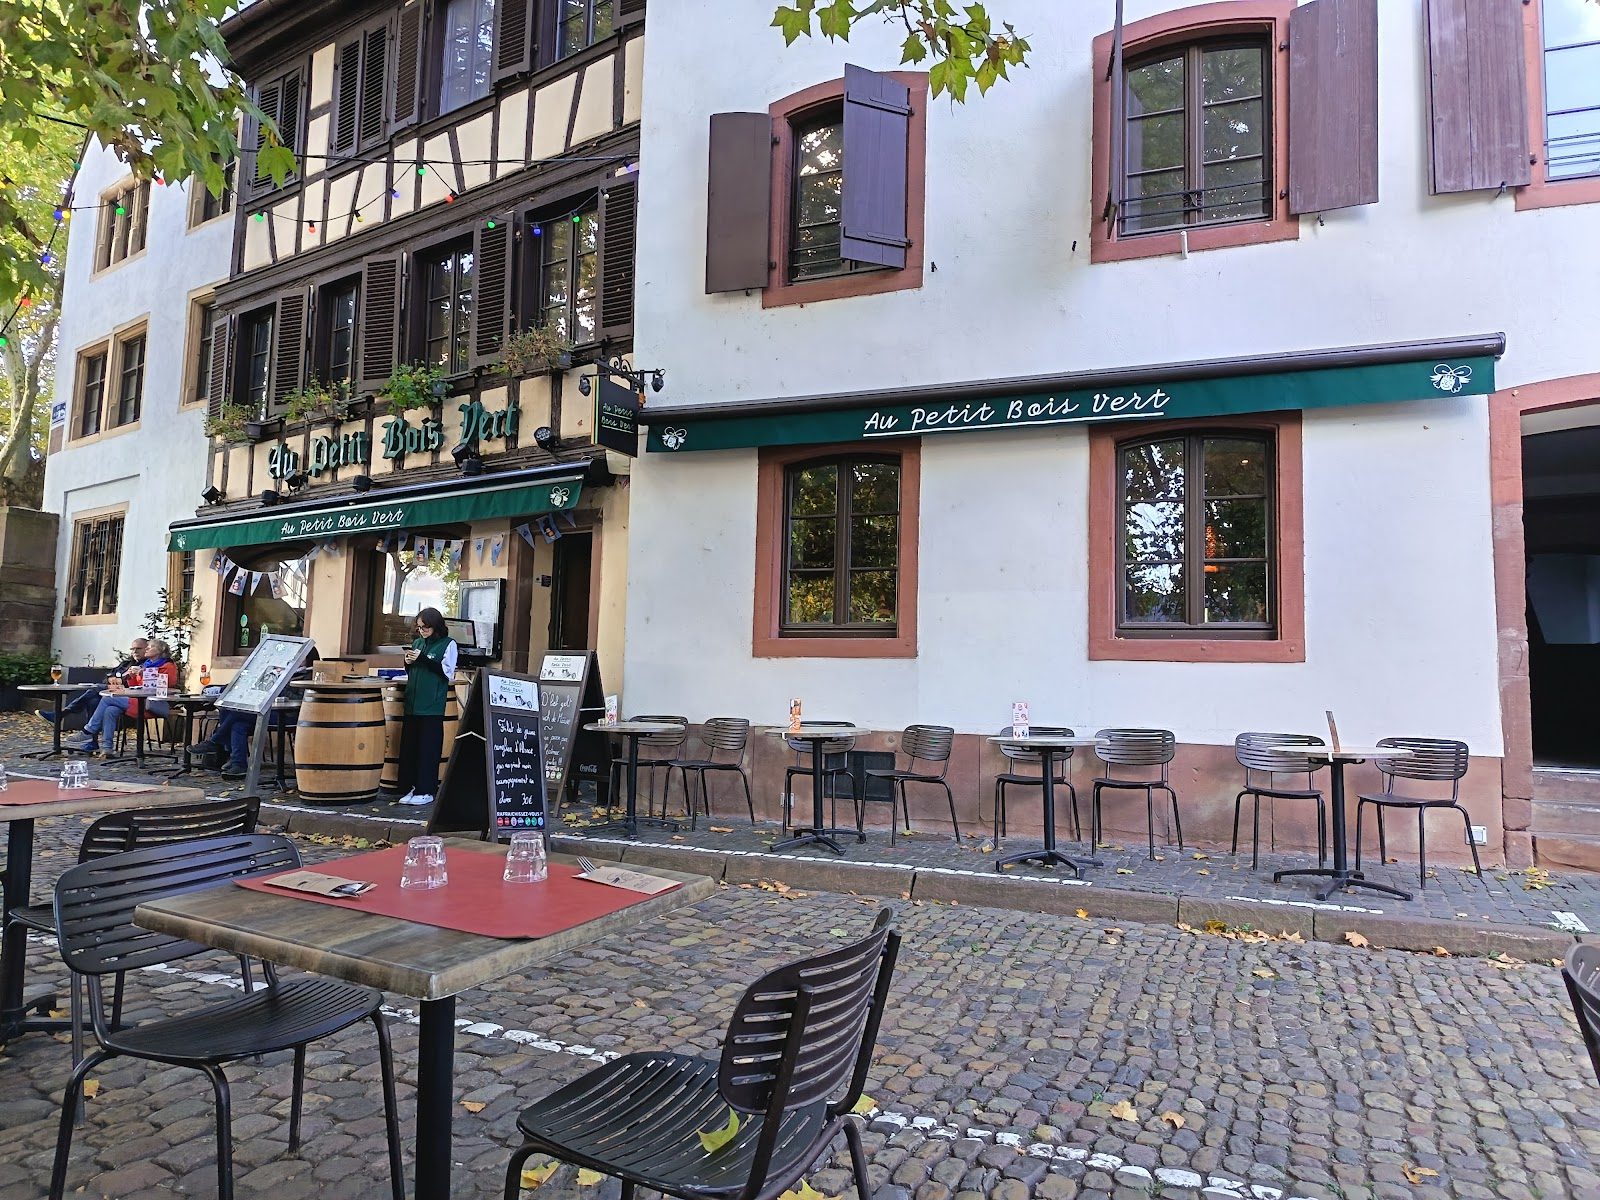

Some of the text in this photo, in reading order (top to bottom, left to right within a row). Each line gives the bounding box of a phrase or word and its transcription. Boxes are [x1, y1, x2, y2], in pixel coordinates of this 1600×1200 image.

[864, 388, 1170, 430] Au Petit Bois Vert
[268, 400, 522, 479] Au Petit Bois Vert
[281, 508, 404, 535] Au Petit Bois Vert
